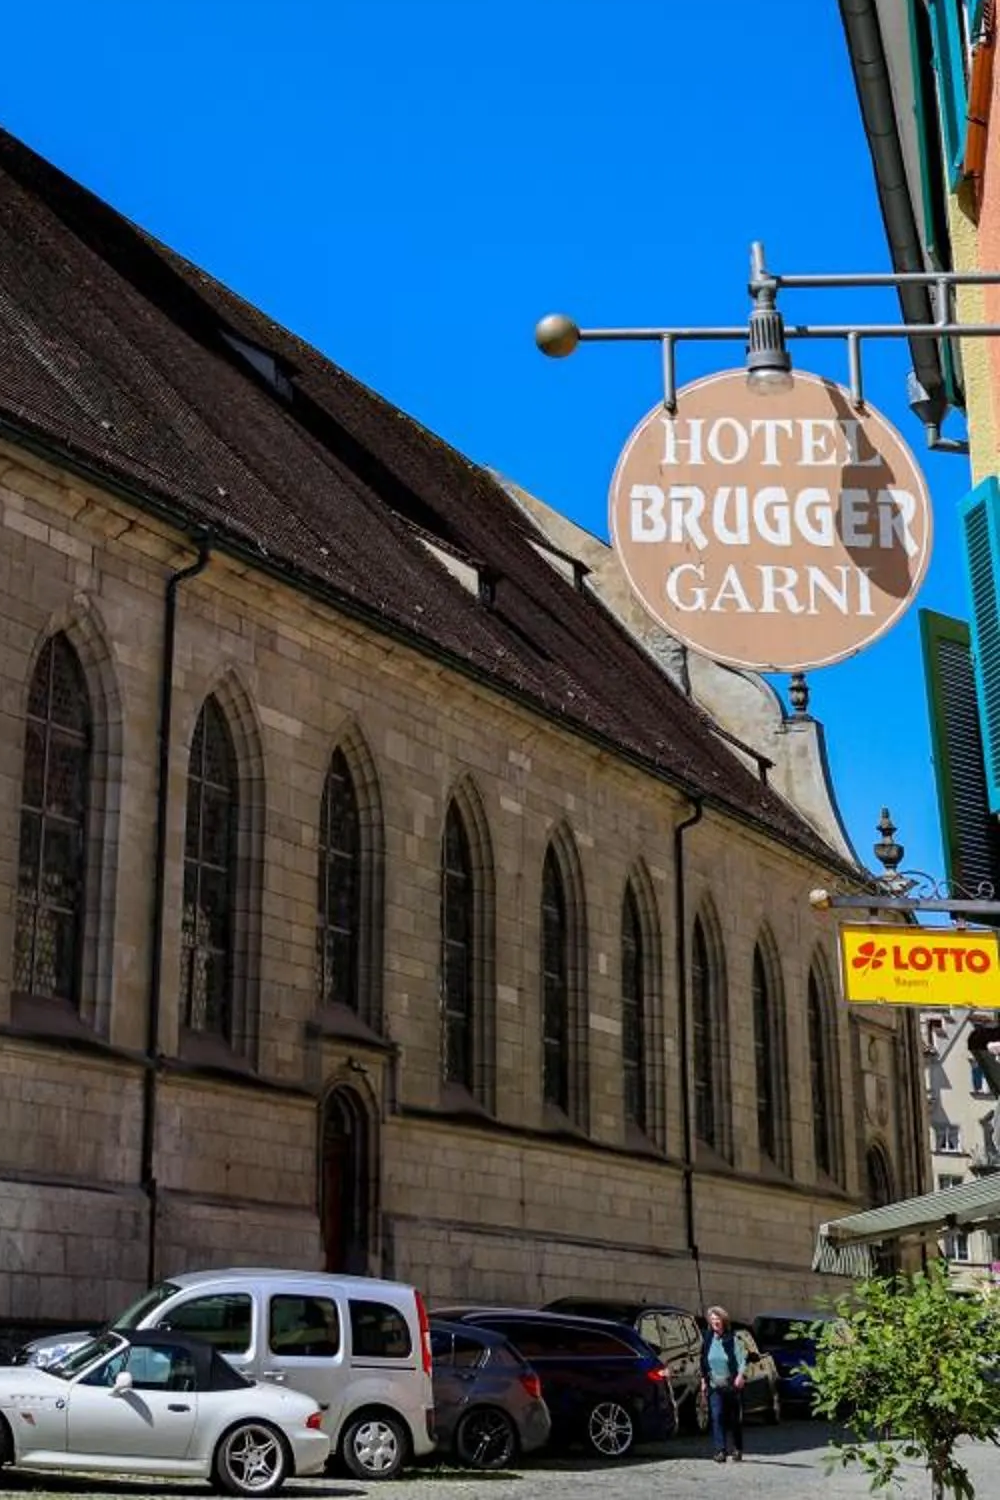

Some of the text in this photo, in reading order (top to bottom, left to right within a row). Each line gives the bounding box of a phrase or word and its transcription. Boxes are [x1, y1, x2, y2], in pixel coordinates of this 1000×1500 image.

[660, 417, 883, 467] HOTEL
[629, 483, 919, 558] BRUGGER
[666, 563, 876, 616] GARNI
[893, 945, 991, 974] LOTTO
